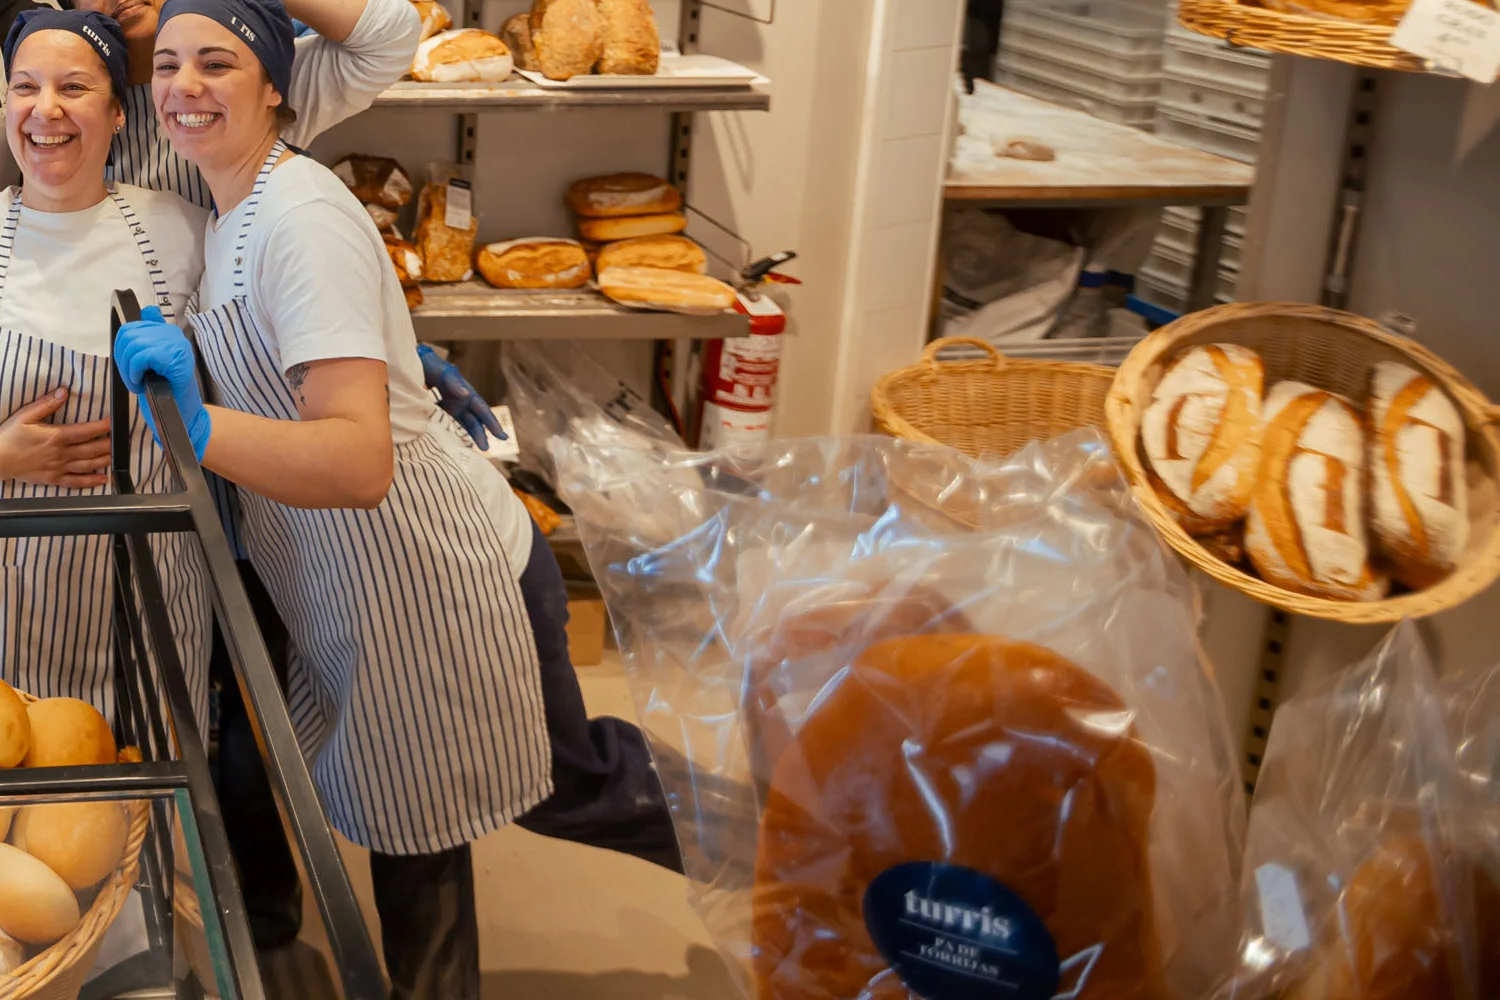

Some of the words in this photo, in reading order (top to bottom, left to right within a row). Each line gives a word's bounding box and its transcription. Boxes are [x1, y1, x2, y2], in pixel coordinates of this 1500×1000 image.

[81, 24, 112, 57] turris
[230, 16, 257, 43] tris
[904, 889, 1013, 940] turris
